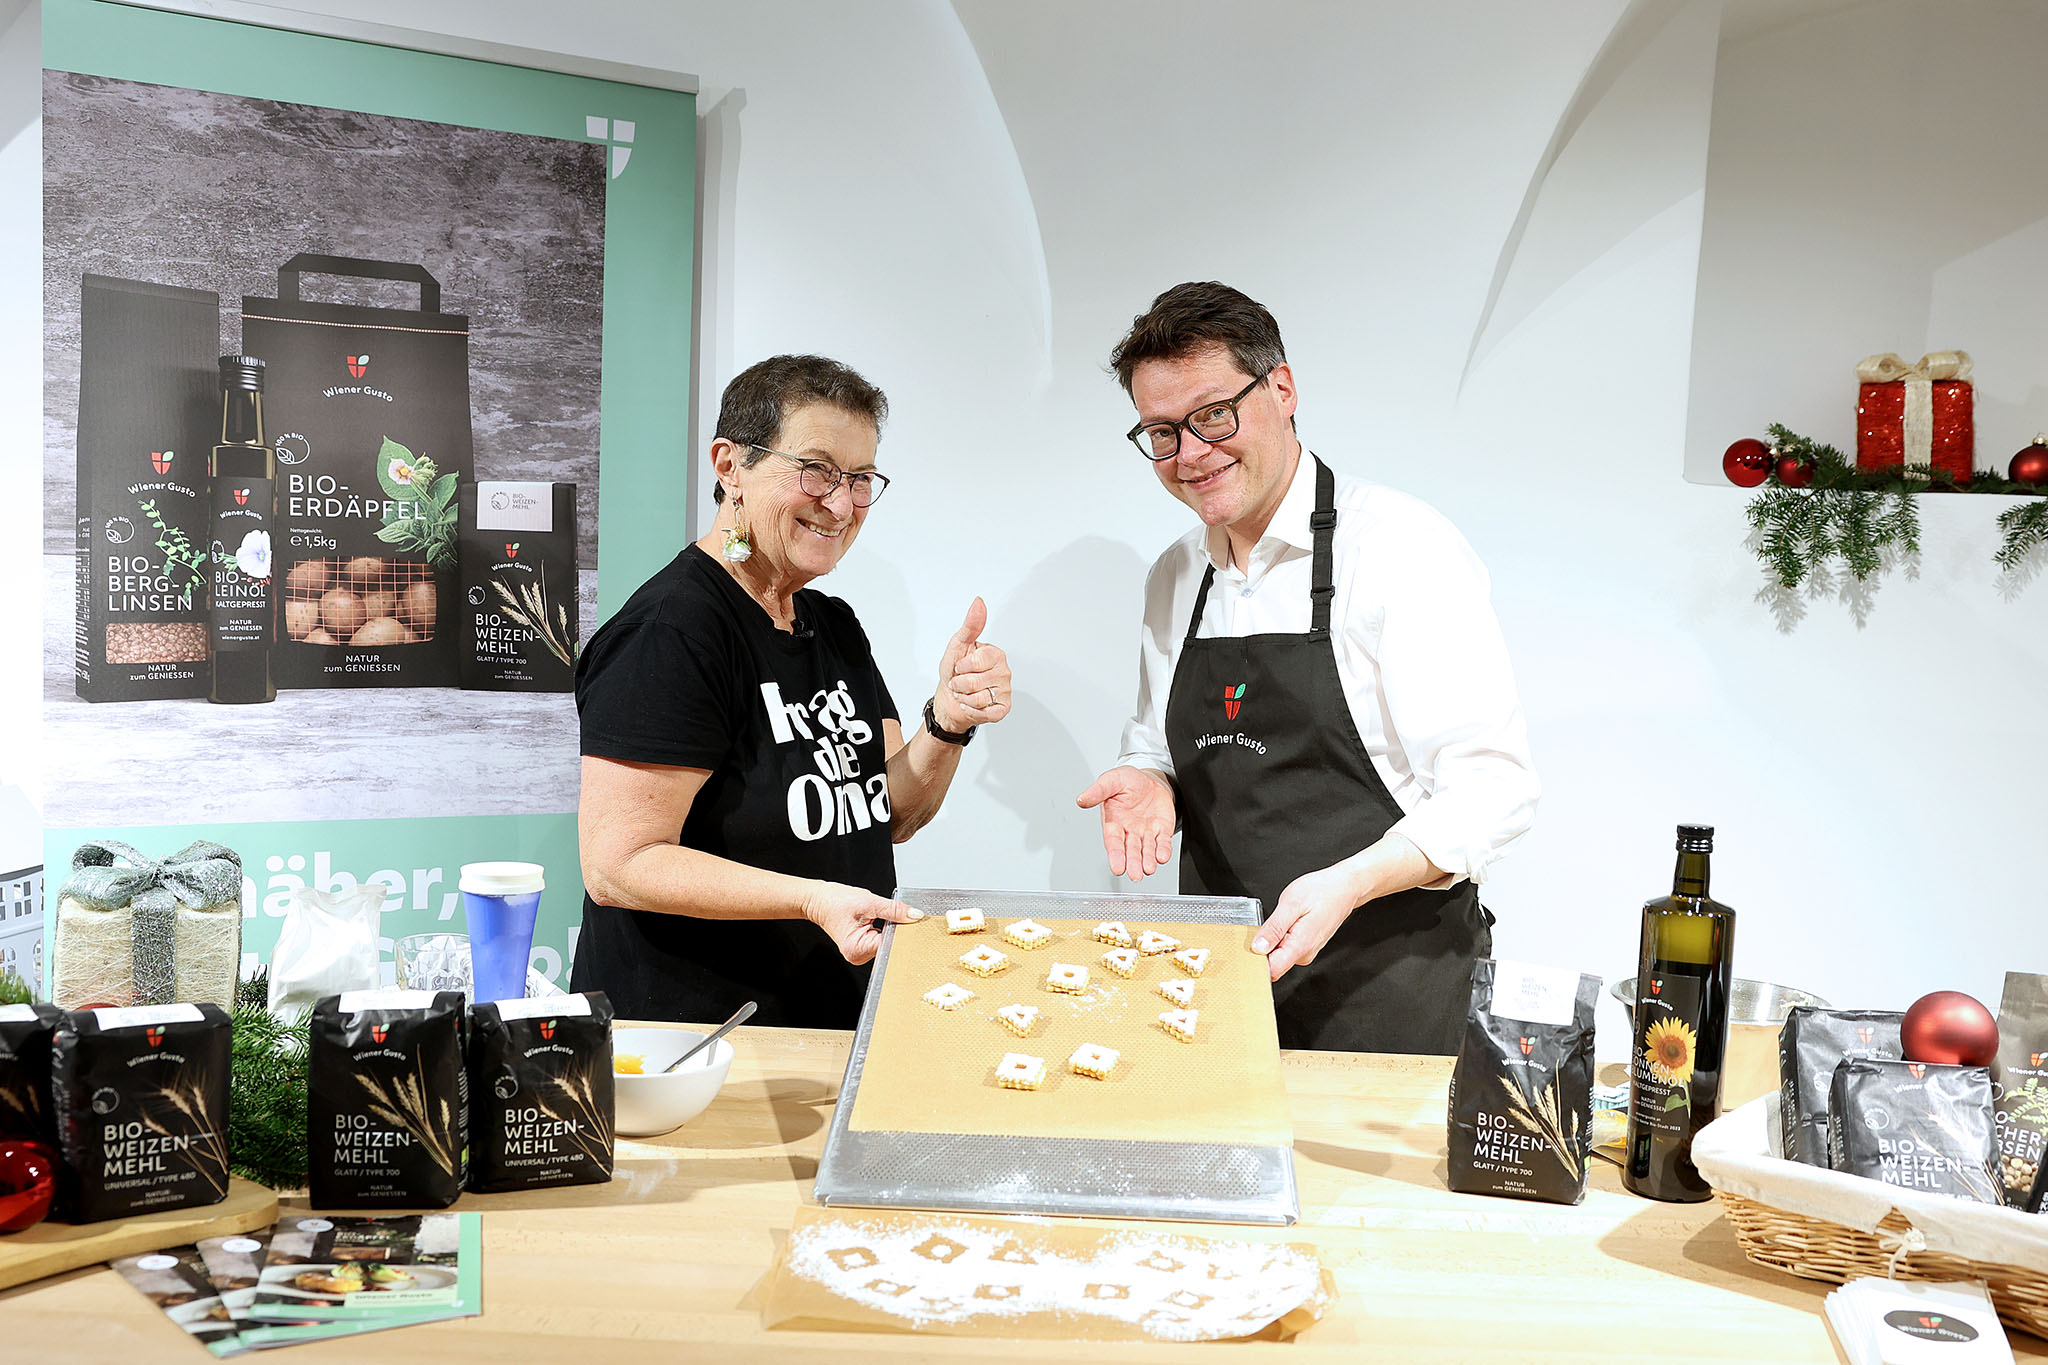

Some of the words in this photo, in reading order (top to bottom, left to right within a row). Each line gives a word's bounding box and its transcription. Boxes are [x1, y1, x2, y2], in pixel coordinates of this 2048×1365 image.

[322, 386, 361, 398] Wiener
[363, 386, 394, 402] Gusto
[291, 432, 304, 440] BIO
[128, 482, 166, 495] Wiener
[168, 481, 196, 498] Gusto
[290, 475, 349, 494] BIO-
[290, 494, 426, 520] ERDÄPFEL
[220, 509, 244, 519] Wiener
[245, 509, 263, 521] Gusto
[304, 536, 337, 550] 1,5kg
[108, 557, 160, 573] BIO-
[491, 562, 514, 572] Wiener
[514, 562, 533, 573] Gusto
[108, 576, 180, 592] BERG-
[215, 571, 247, 584] BIO-
[215, 582, 266, 597] LEINÖL
[108, 595, 193, 611] LINSEN
[476, 613, 507, 626] BIO-
[476, 627, 540, 642] WEIZEN-
[476, 640, 518, 655] MEHL
[148, 664, 177, 672] NATUR
[148, 671, 194, 680] GENIESSEN
[345, 664, 401, 672] GENIESSEN
[1195, 734, 1233, 749] Wiener
[1236, 733, 1267, 755] Gusto
[1657, 999, 1674, 1011] Gusto
[353, 1050, 382, 1061] Wiener
[383, 1049, 406, 1060] Gusto
[524, 1046, 551, 1058] Wiener
[552, 1044, 574, 1055] Gusto
[1870, 1048, 1893, 1058] Gusto
[127, 1054, 159, 1067] Wiener
[160, 1051, 185, 1064] Gusto
[1501, 1058, 1528, 1066] Wiener
[1528, 1060, 1547, 1073] Gusto
[1632, 1056, 1675, 1075] ONNEN-
[1893, 1084, 1922, 1093] Wiener
[335, 1114, 377, 1129] BIO-
[505, 1107, 547, 1124] BIO-
[1478, 1112, 1515, 1130] BIO-
[1995, 1111, 2016, 1124] O-
[104, 1122, 152, 1141] BIO-
[504, 1119, 585, 1140] WEIZEN-
[1996, 1125, 2047, 1147] CHER-
[104, 1134, 198, 1159] WEIZEN-
[335, 1132, 419, 1147] WEIZEN-
[504, 1137, 558, 1155] MEHL
[1477, 1127, 1551, 1152] WEIZEN-
[334, 1149, 389, 1164] MEHL
[1474, 1142, 1524, 1164] MEHL
[1998, 1141, 2041, 1161] BSEN
[103, 1156, 166, 1177] MEHL
[505, 1158, 545, 1167] UNIVERSAL
[552, 1155, 569, 1163] TYPE
[570, 1153, 584, 1161] 480
[1473, 1161, 1495, 1170] GLATT
[1502, 1166, 1518, 1174] TYPE
[1520, 1168, 1533, 1176] 700
[104, 1178, 151, 1190] UNIVERSAL
[159, 1174, 178, 1183] TYPE
[180, 1171, 196, 1180] 480
[1881, 1170, 1942, 1188] MEHL
[1504, 1186, 1537, 1194] GENIESSEN
